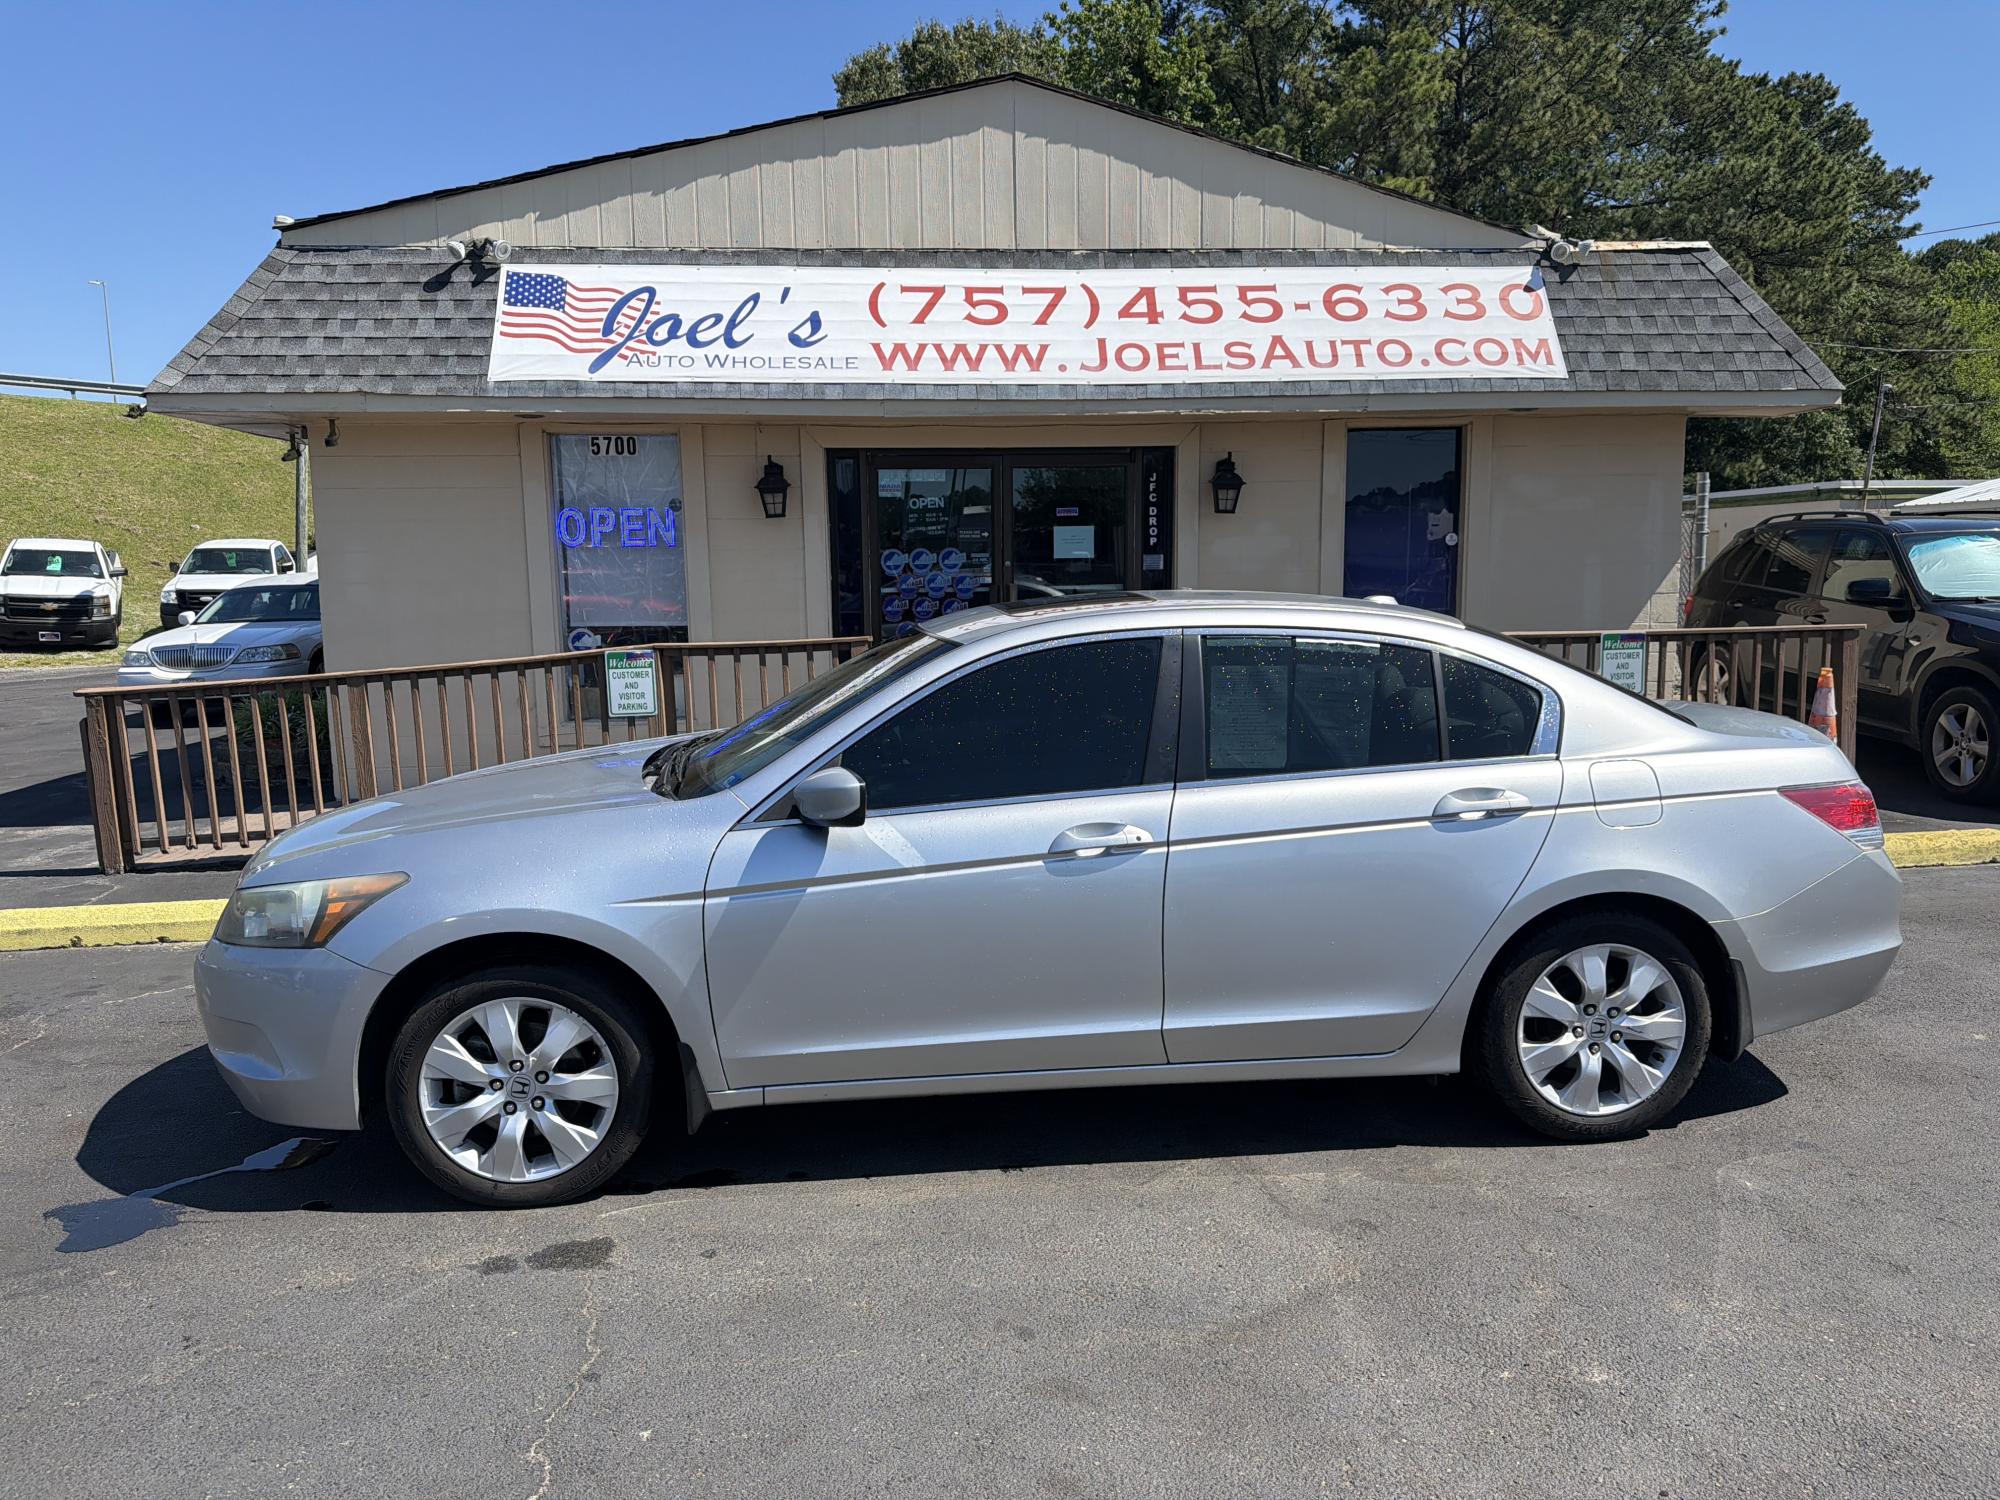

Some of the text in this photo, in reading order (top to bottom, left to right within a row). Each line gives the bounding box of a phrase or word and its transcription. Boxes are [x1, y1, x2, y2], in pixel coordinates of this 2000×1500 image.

[868, 281, 1544, 330] (757)455-6330
[588, 286, 827, 374] Joel's
[626, 351, 859, 370] AUTO WHOLESALE
[590, 436, 637, 456] 5700
[908, 497, 945, 509] OPEN
[556, 506, 677, 549] OPEN
[1148, 506, 1158, 546] DROP
[1604, 639, 1643, 650] Welcome
[1605, 651, 1641, 661] CUSTOMER
[608, 658, 651, 669] Welcome
[1615, 662, 1630, 670] AND
[611, 670, 650, 680] CUSTOMER
[1610, 671, 1636, 681] VISITOR
[624, 681, 639, 690] AND
[618, 691, 646, 701] VISITOR
[617, 702, 648, 712] PARKING
